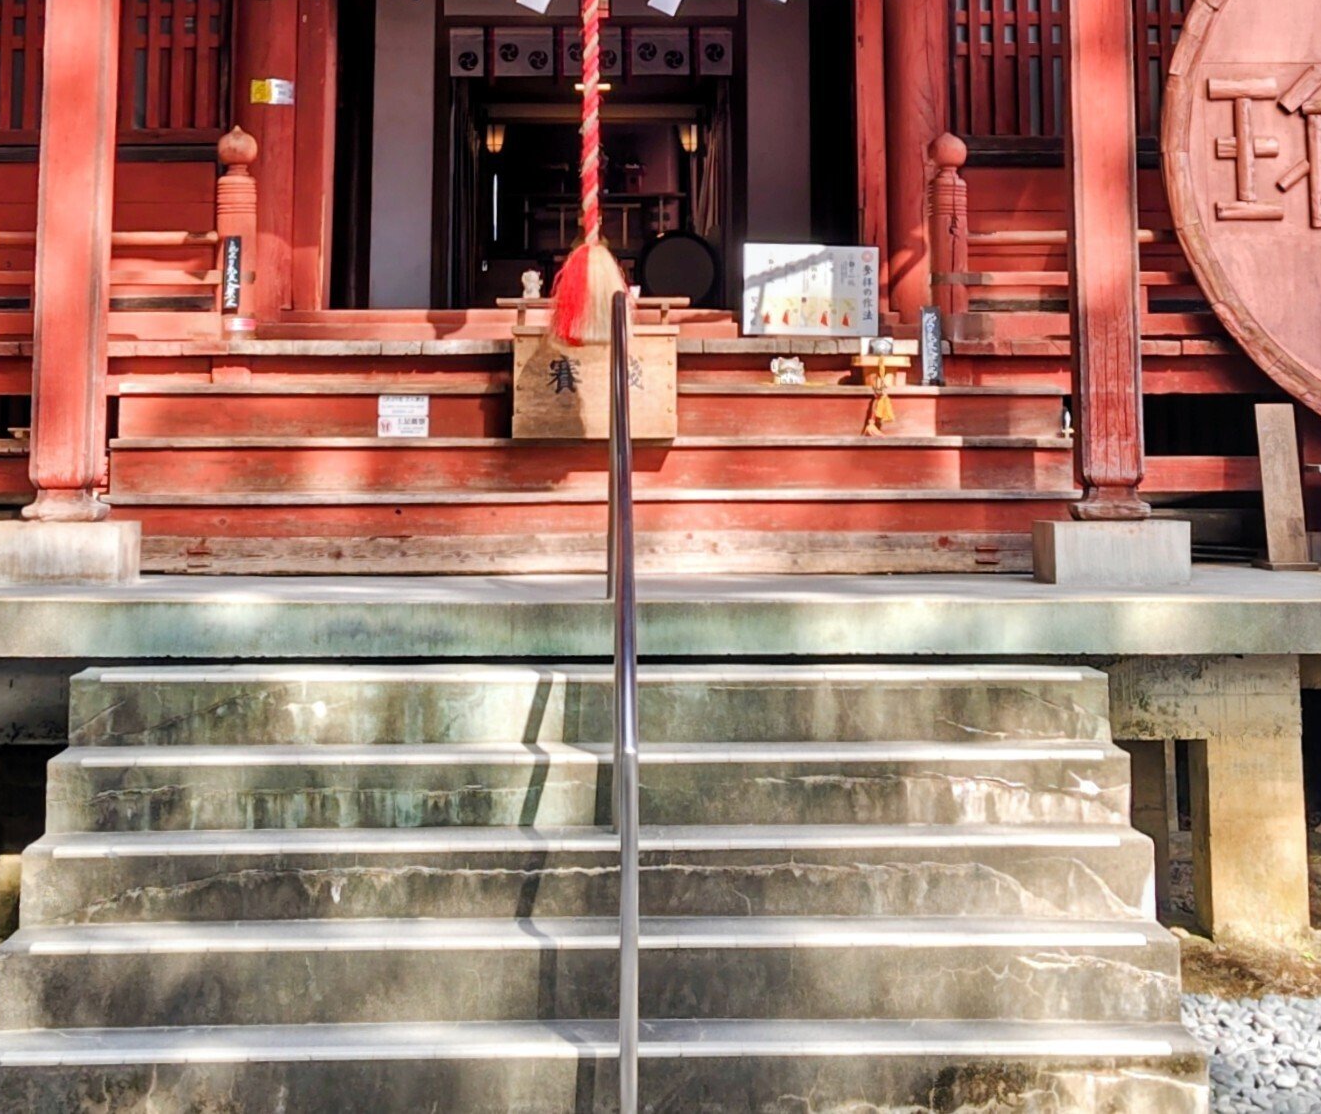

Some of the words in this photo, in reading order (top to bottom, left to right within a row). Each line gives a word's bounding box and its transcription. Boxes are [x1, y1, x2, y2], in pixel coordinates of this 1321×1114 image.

[862, 263, 874, 321] 参拝の作法
